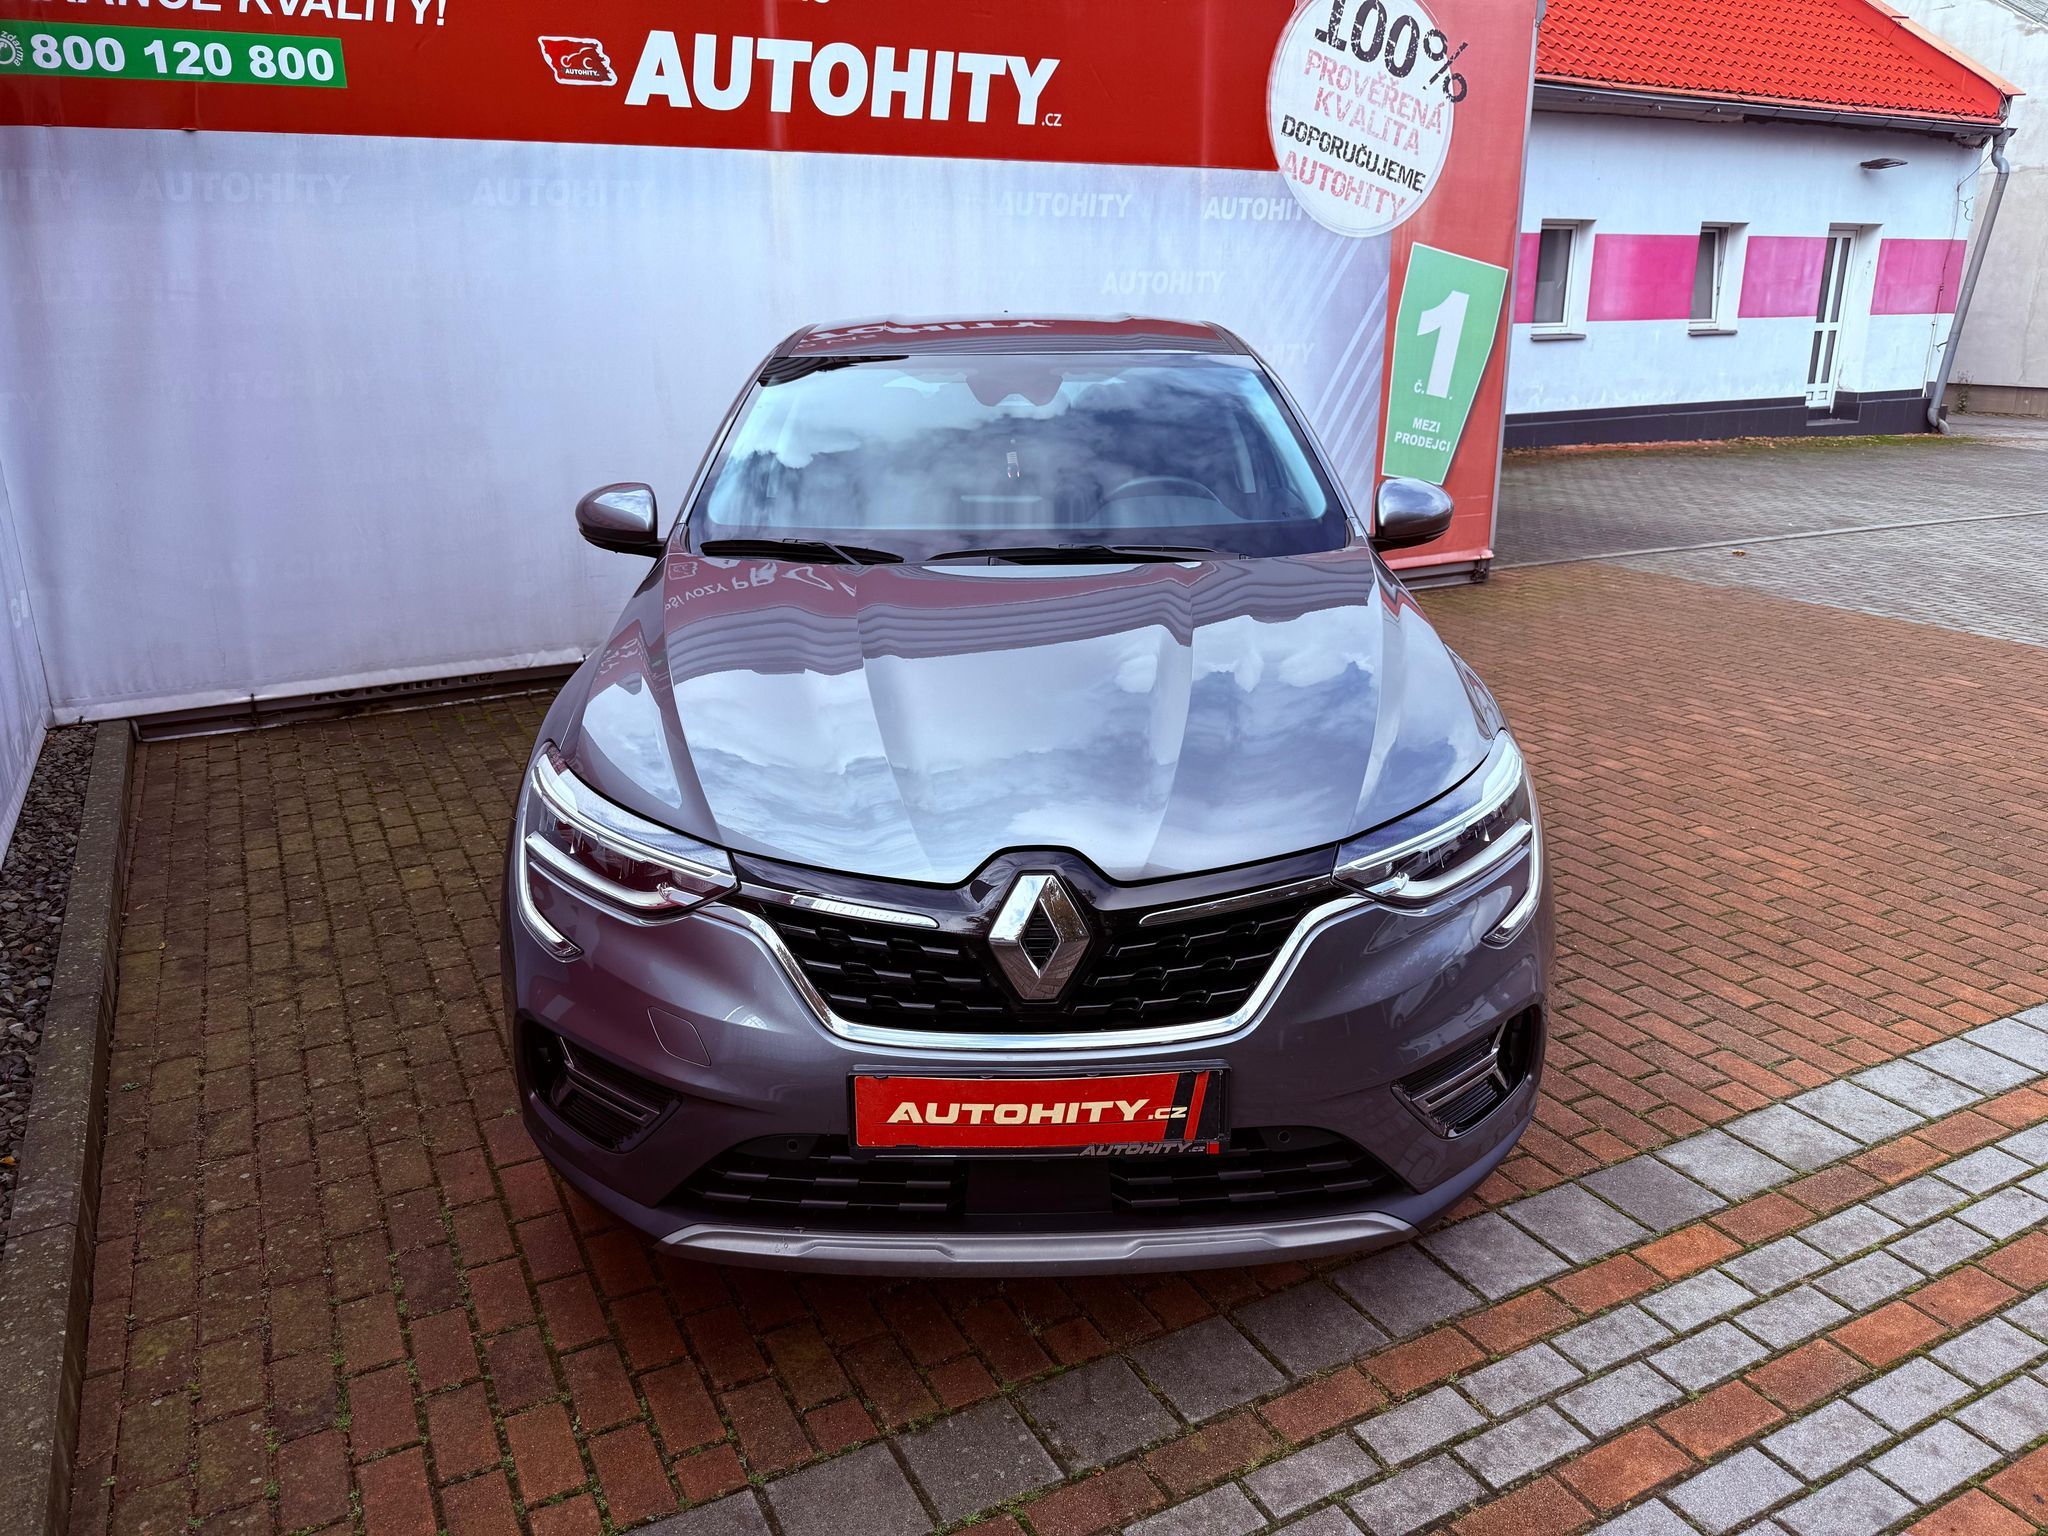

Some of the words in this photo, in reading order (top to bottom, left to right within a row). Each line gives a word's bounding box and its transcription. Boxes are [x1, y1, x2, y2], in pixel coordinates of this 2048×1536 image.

[31, 33, 126, 73] 800
[143, 39, 233, 77] 120
[249, 44, 335, 82] 800
[1314, 0, 1469, 103] 100%
[1304, 49, 1445, 134] PROVĚŘENÁ
[1314, 87, 1420, 155] KVALITA
[1280, 114, 1427, 194] DOPORUČUJEME
[1203, 196, 1302, 221] AUTOHI
[1281, 150, 1407, 221] AUTOHITY
[1102, 270, 1226, 296] AUTOHITY
[1394, 431, 1451, 452] PRODEJCI
[1412, 417, 1441, 433] MEZI
